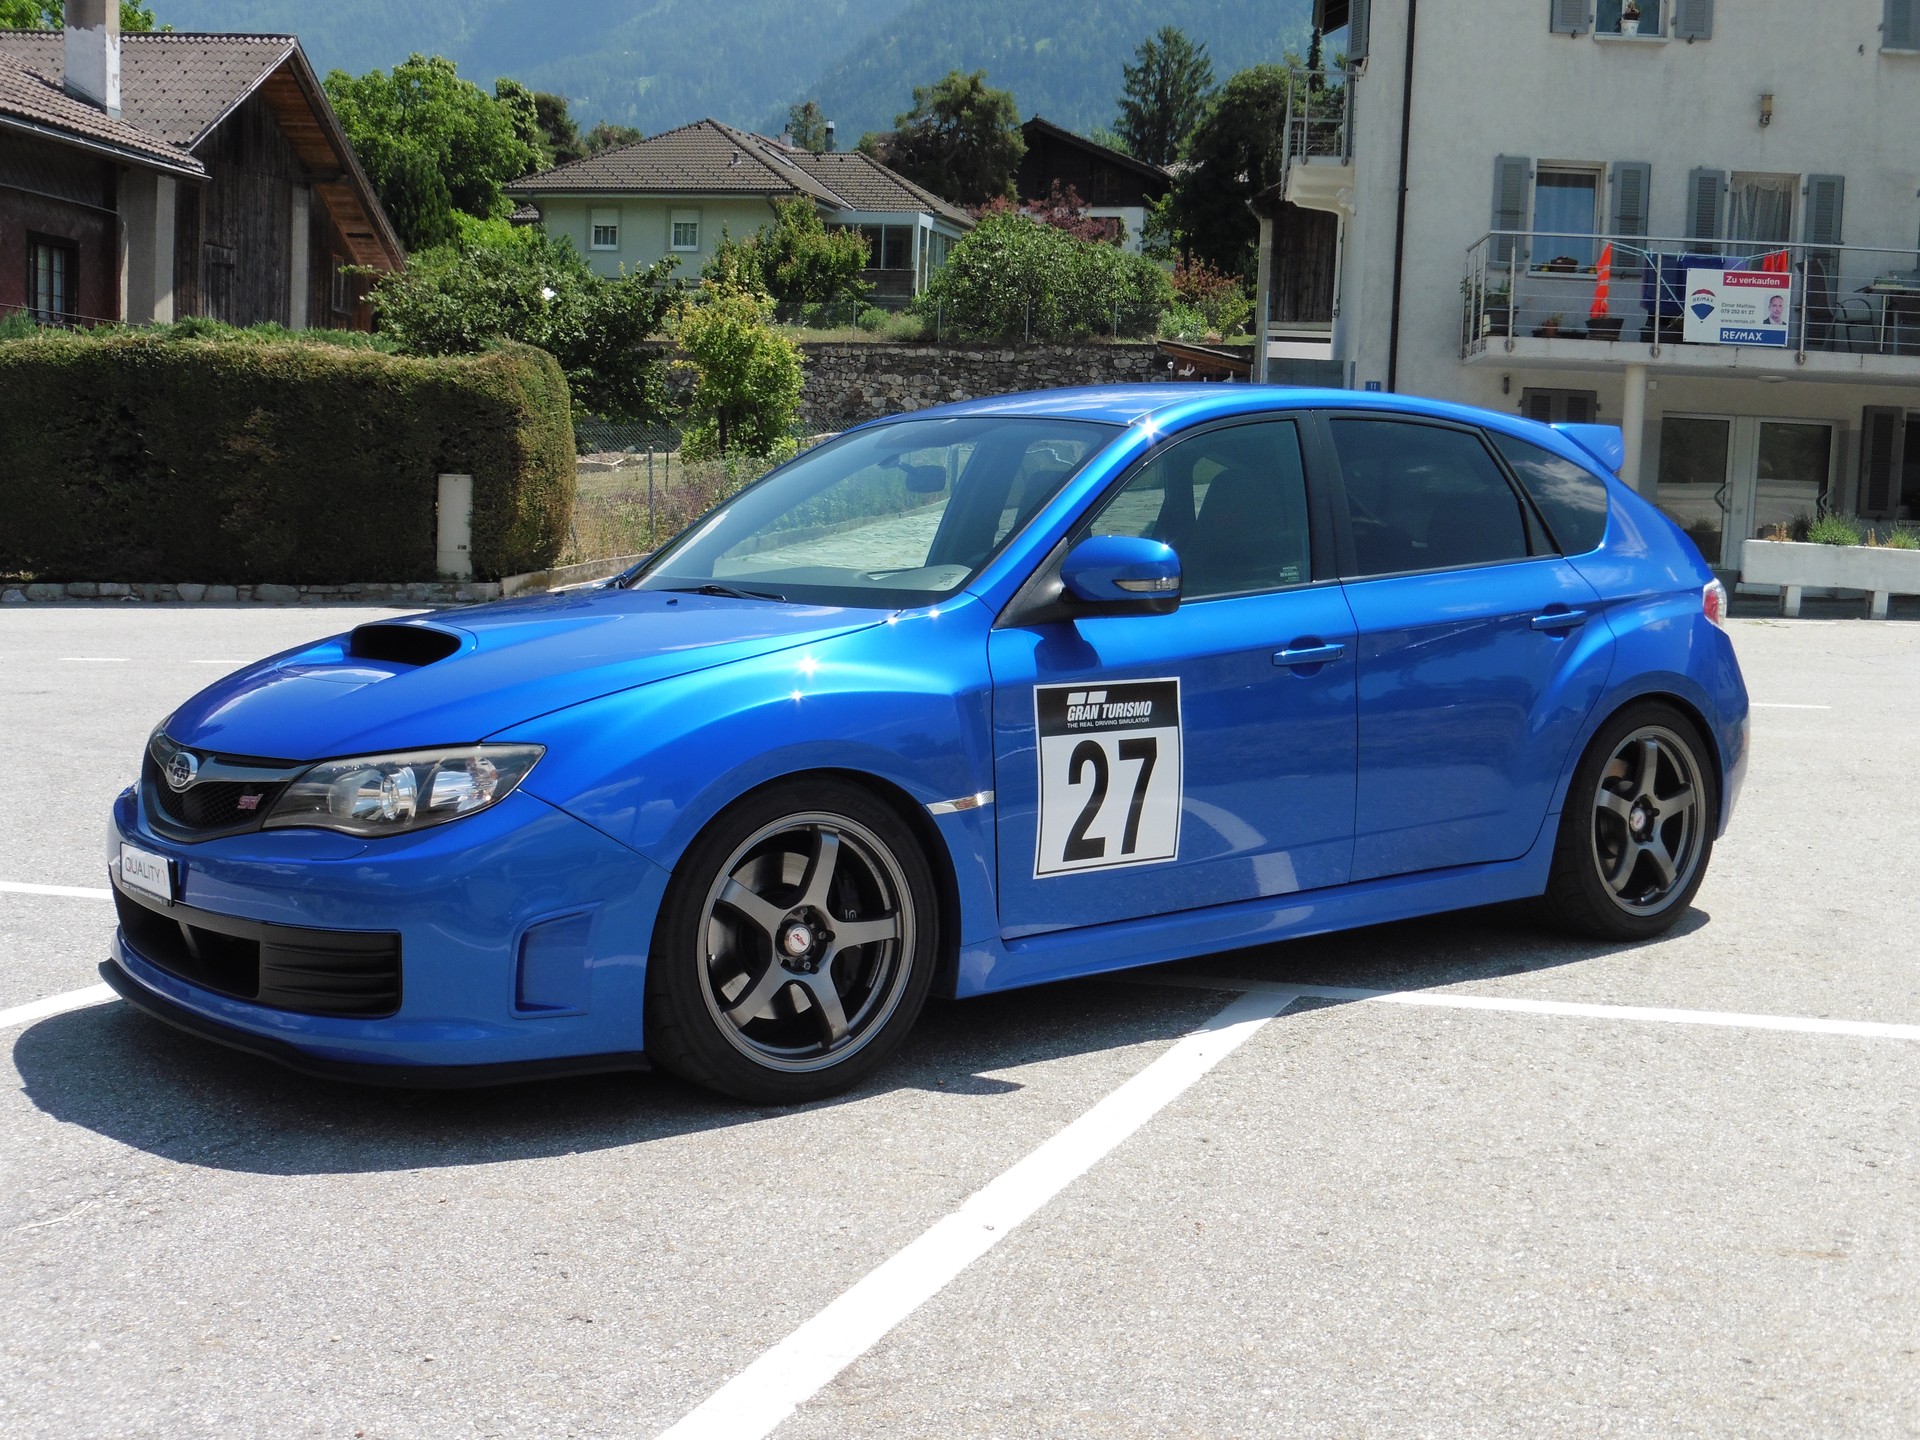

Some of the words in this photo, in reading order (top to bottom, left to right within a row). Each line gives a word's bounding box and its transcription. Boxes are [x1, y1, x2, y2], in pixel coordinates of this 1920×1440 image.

[1726, 275, 1737, 284] Zu
[1739, 276, 1780, 286] verkaufen
[1722, 330, 1763, 341] RE/MAX
[1067, 704, 1099, 722] GRAN
[1102, 701, 1152, 719] TURISMO
[1095, 719, 1118, 727] DRIVING
[1118, 717, 1150, 725] SIMULATOR
[1062, 736, 1158, 863] 27
